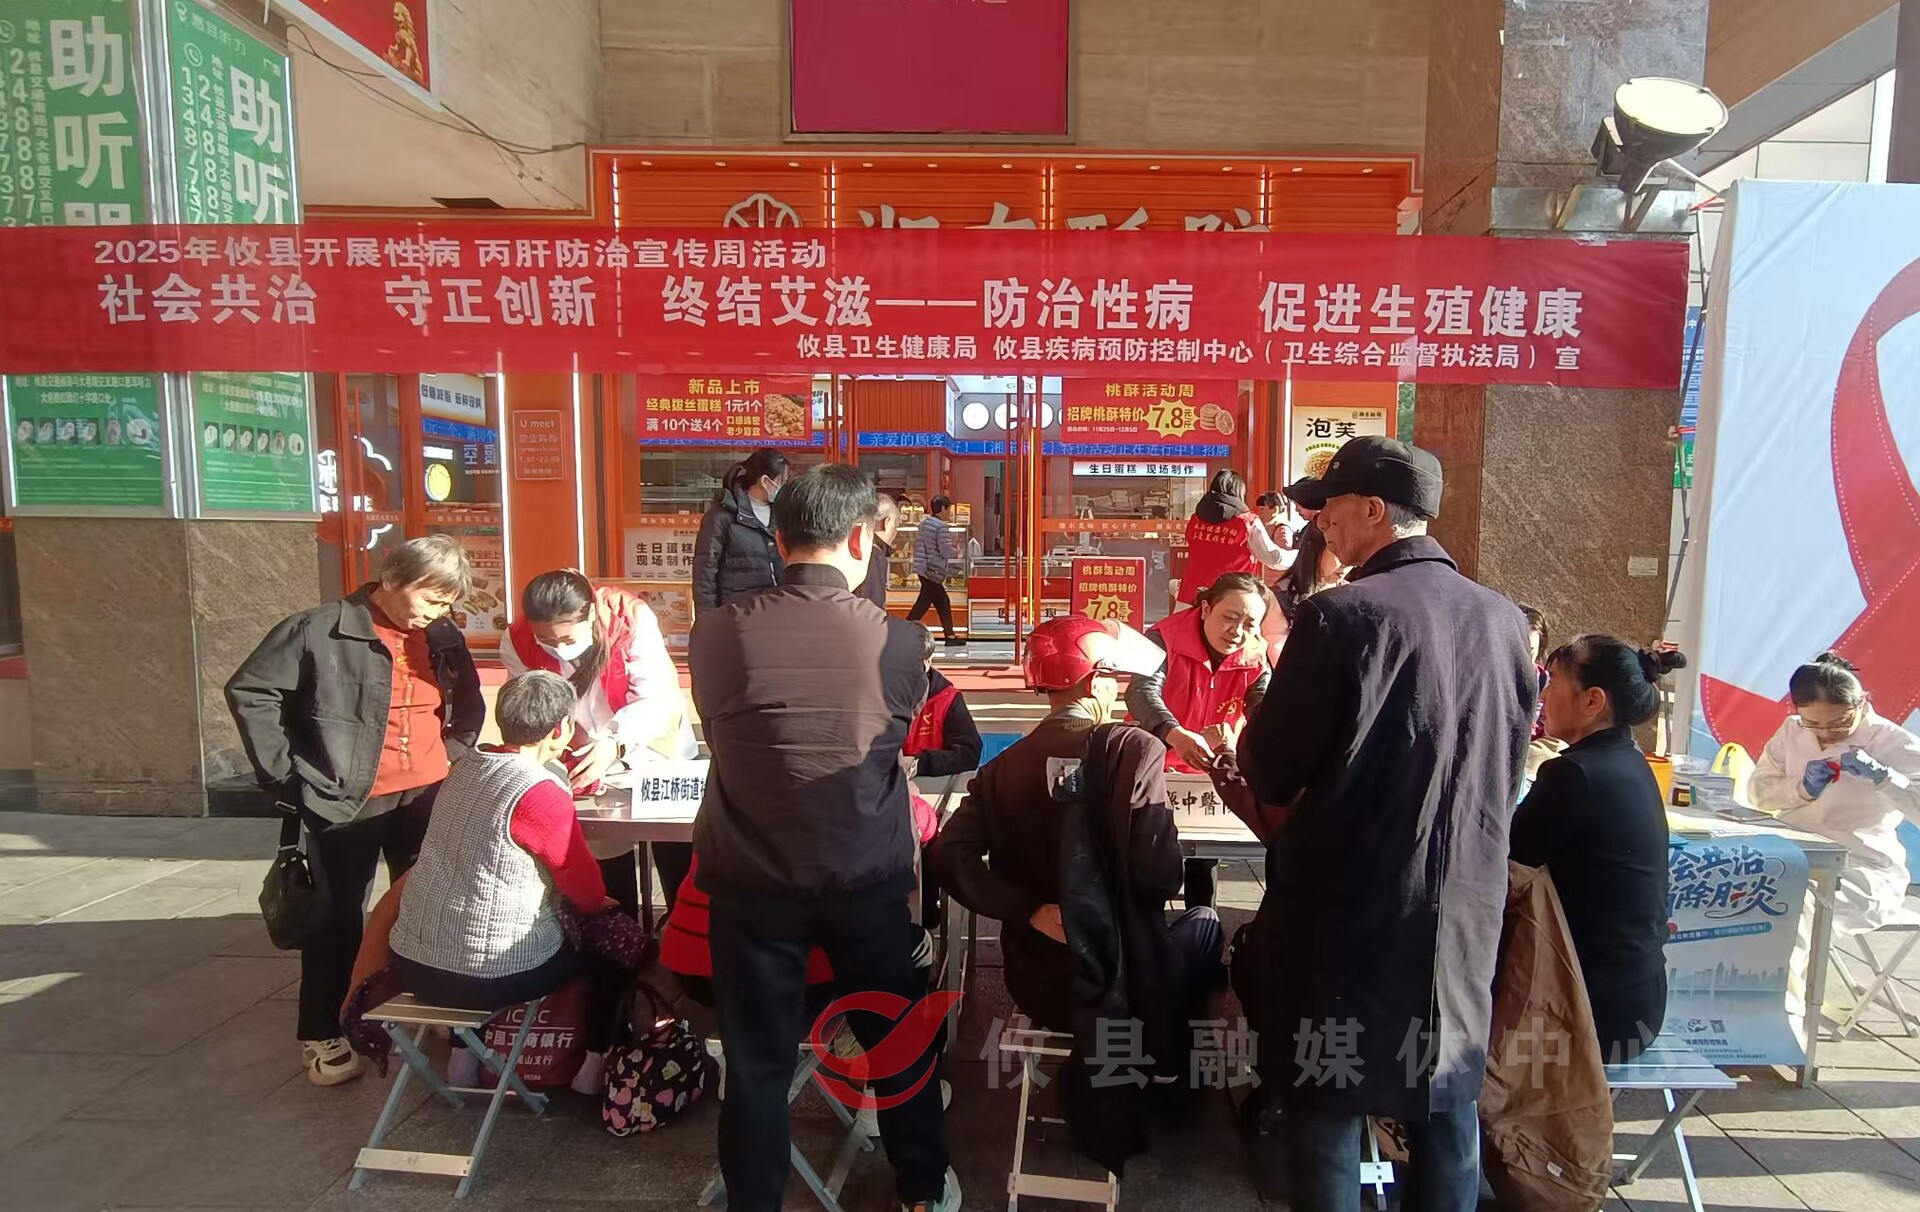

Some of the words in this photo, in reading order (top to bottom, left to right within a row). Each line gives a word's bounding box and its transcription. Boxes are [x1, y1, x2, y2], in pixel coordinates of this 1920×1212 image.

[47, 16, 133, 225] 助听
[10, 48, 36, 226] 248887
[95, 236, 461, 267] 2025年攸县开展性病
[474, 238, 827, 268] 丙肝防治宣传周活动
[98, 274, 317, 324] 社会共治
[385, 275, 596, 326] 守正创新
[662, 275, 1194, 331] 终结艾滋——防治性病
[1259, 282, 1584, 338] 促进生殖健康
[797, 334, 978, 360] 攸县卫生健康局
[688, 379, 760, 395] 新品上市
[1105, 384, 1194, 397] 桃酥活动周
[646, 398, 722, 411] 经典拨丝蛋糕
[725, 400, 762, 412] 1元1个
[1067, 407, 1145, 422] 招牌桃酥特价
[1152, 407, 1183, 429] 7.8
[1306, 418, 1356, 438] 泡芙
[869, 432, 945, 447] 亲爱的顾客
[1089, 463, 1137, 474] 生日蛋糕
[1146, 463, 1194, 474] 现场制作
[636, 542, 693, 554] 生日蛋糕
[636, 555, 694, 566] 现场制作
[1082, 565, 1135, 576] 桃酥活动周
[1078, 582, 1137, 593] 招牌桃酥特价
[506, 1009, 551, 1023] ICC
[485, 1028, 574, 1048] 中国工商银行
